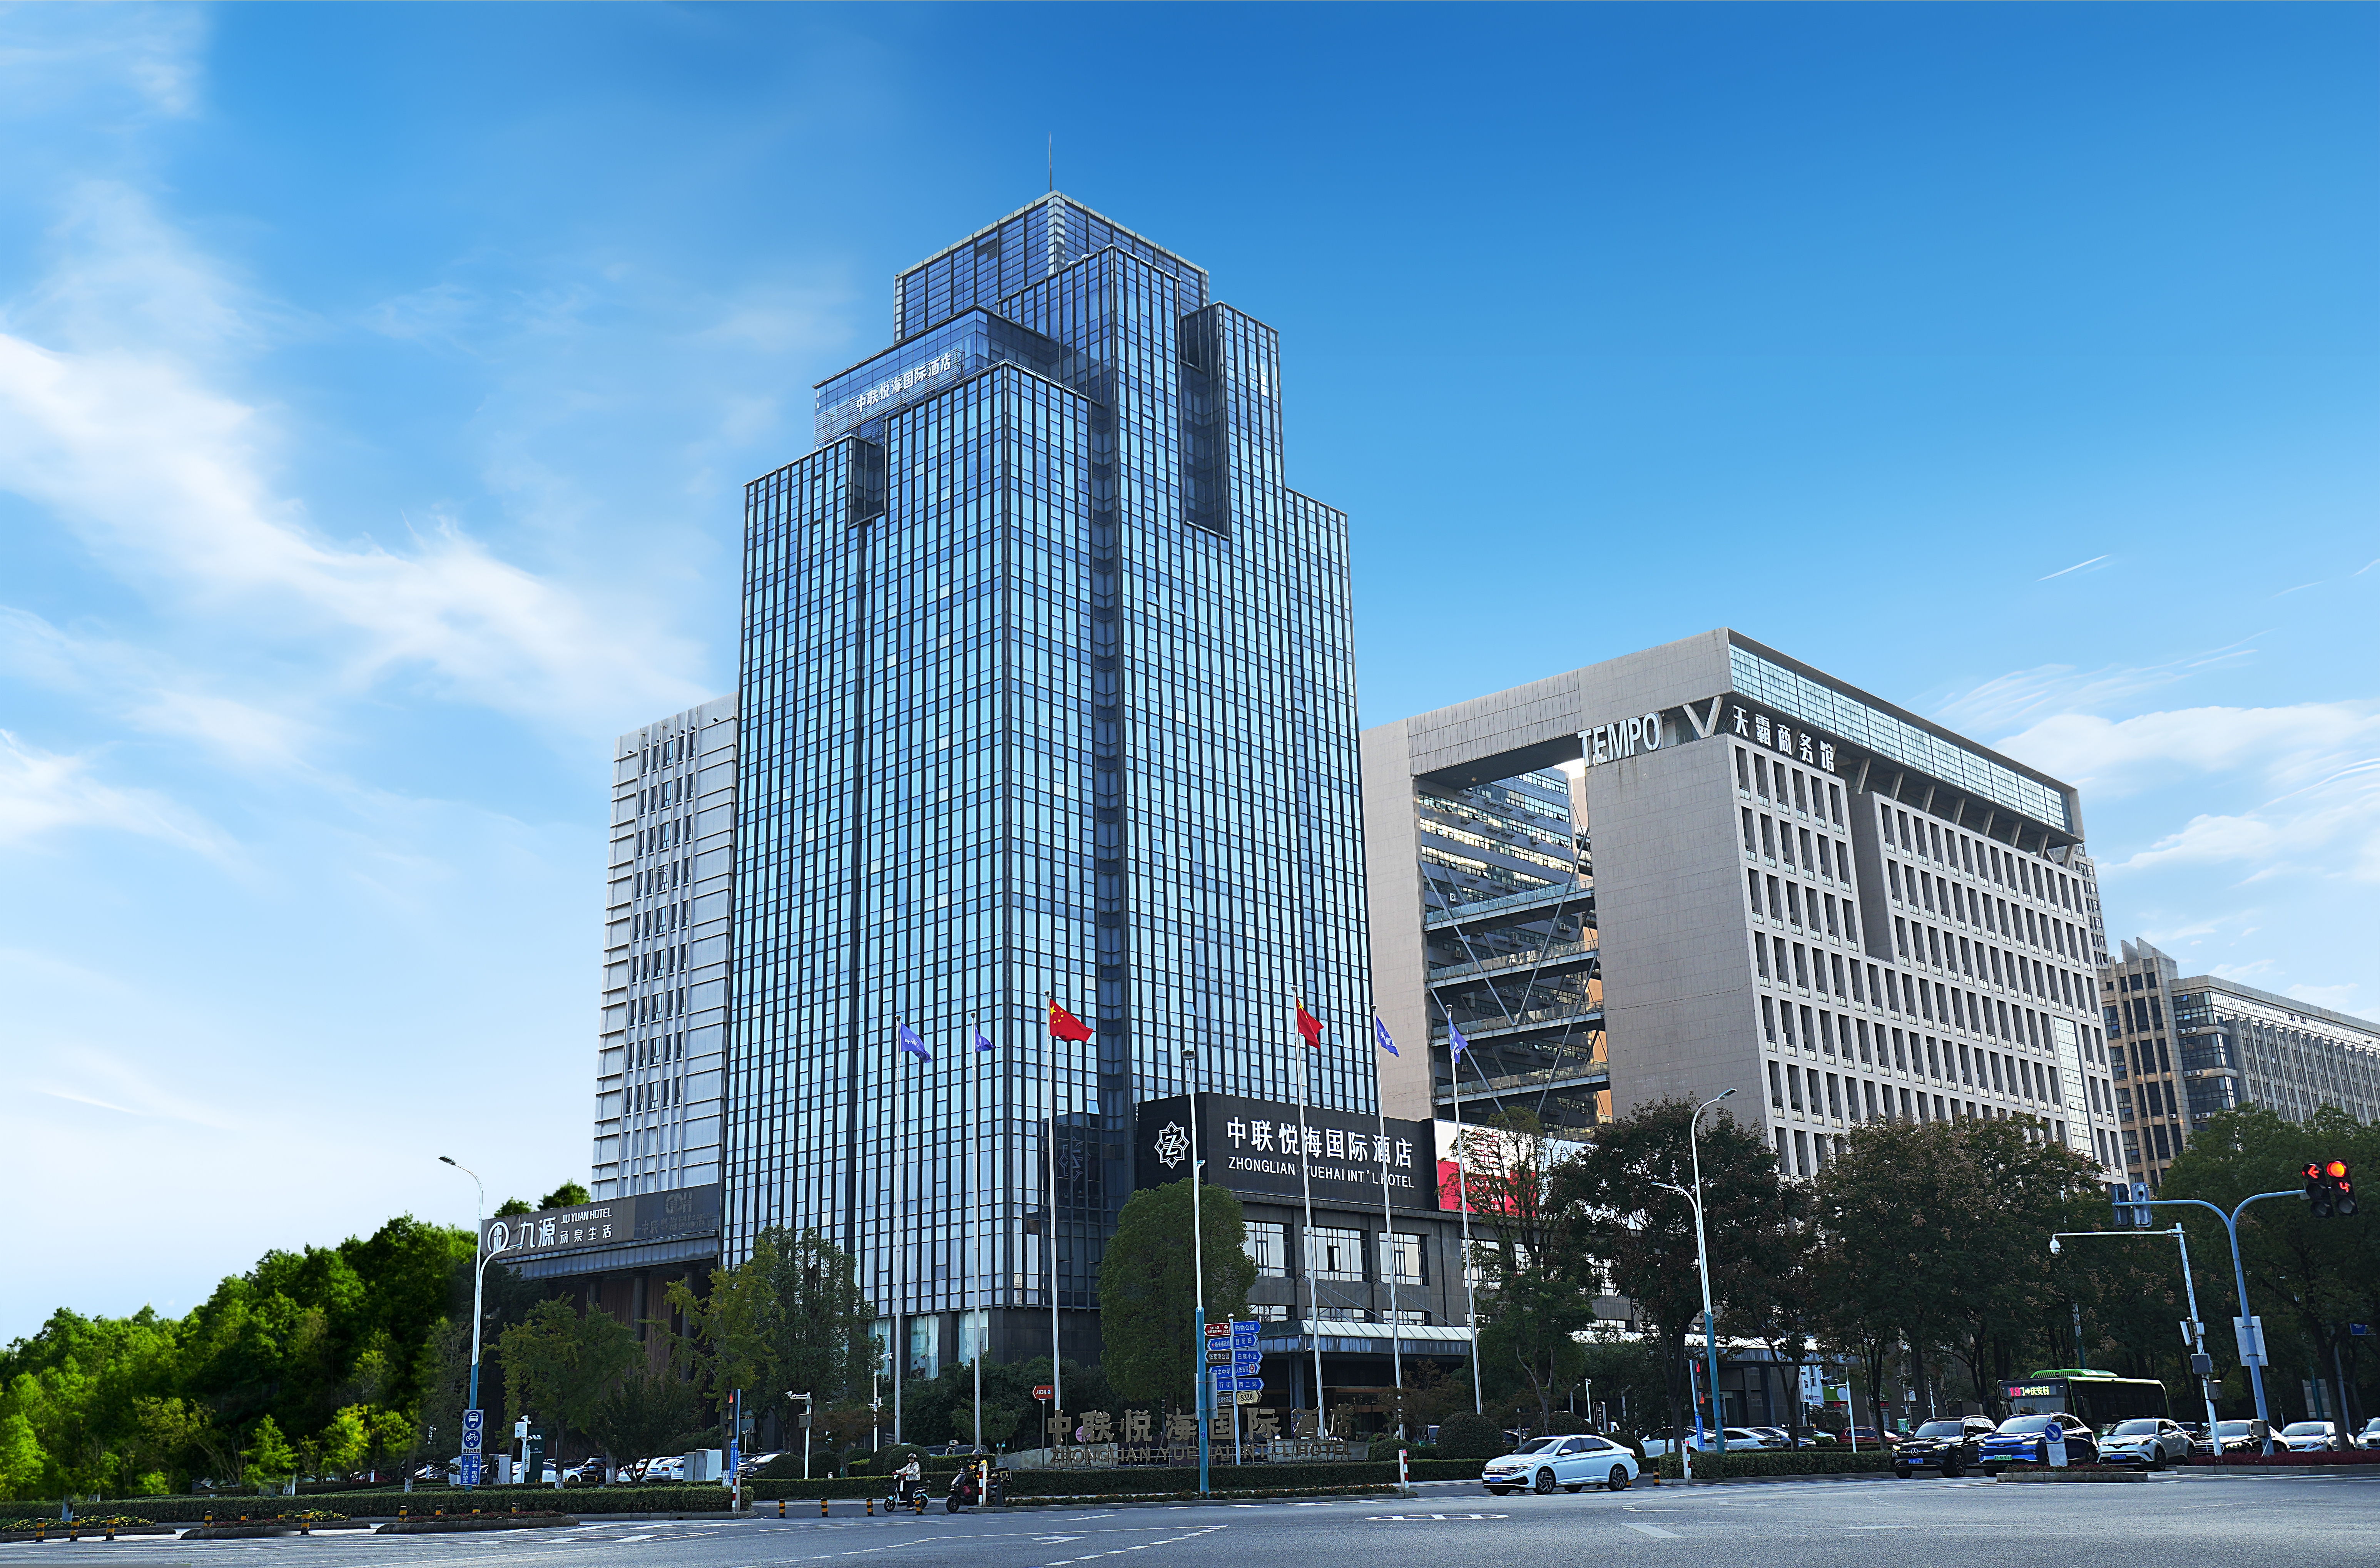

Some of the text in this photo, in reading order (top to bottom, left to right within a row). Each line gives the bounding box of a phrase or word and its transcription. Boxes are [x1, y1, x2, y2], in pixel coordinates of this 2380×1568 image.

[857, 353, 951, 413] 中联悦海国际酒店
[1578, 713, 1660, 767] TEMPO
[1733, 705, 1835, 773] 天霸商务馆
[1227, 1116, 1412, 1169] 中联悦海国际酒店
[1228, 1156, 1295, 1176] ZHONGLIAN
[590, 1208, 612, 1220] HOTEL
[520, 1217, 557, 1250] 九源
[560, 1224, 612, 1244] 汤泉生活
[2009, 1387, 2021, 1397] 19
[2030, 1386, 2050, 1396] 庆安村
[1047, 1404, 1353, 1444] 中联悦海国际酒店
[1050, 1447, 1150, 1464] ZHONGLIAN
[1297, 1441, 1352, 1457] HOTEL
